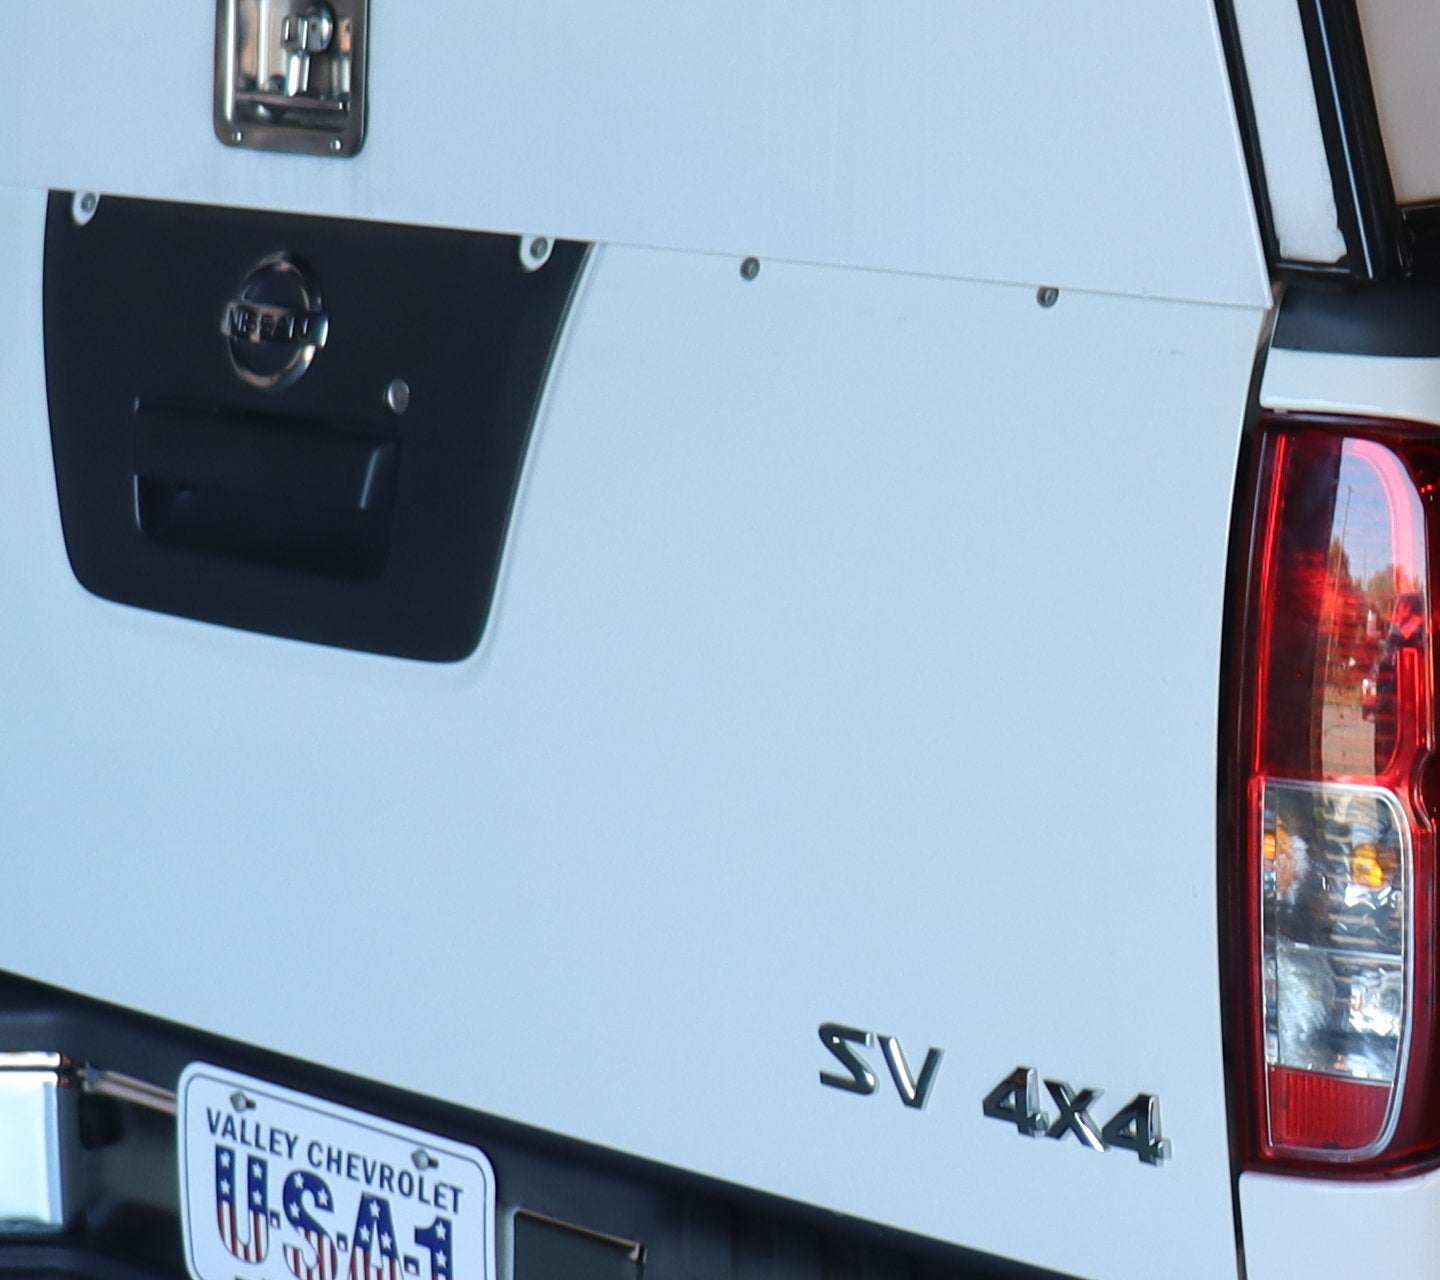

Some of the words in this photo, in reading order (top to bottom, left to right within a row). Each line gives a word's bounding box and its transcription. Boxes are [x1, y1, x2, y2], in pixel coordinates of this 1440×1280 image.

[818, 1022, 945, 1110] SV
[207, 1107, 300, 1160] VALLEY
[306, 1140, 464, 1215] CHEVROLET
